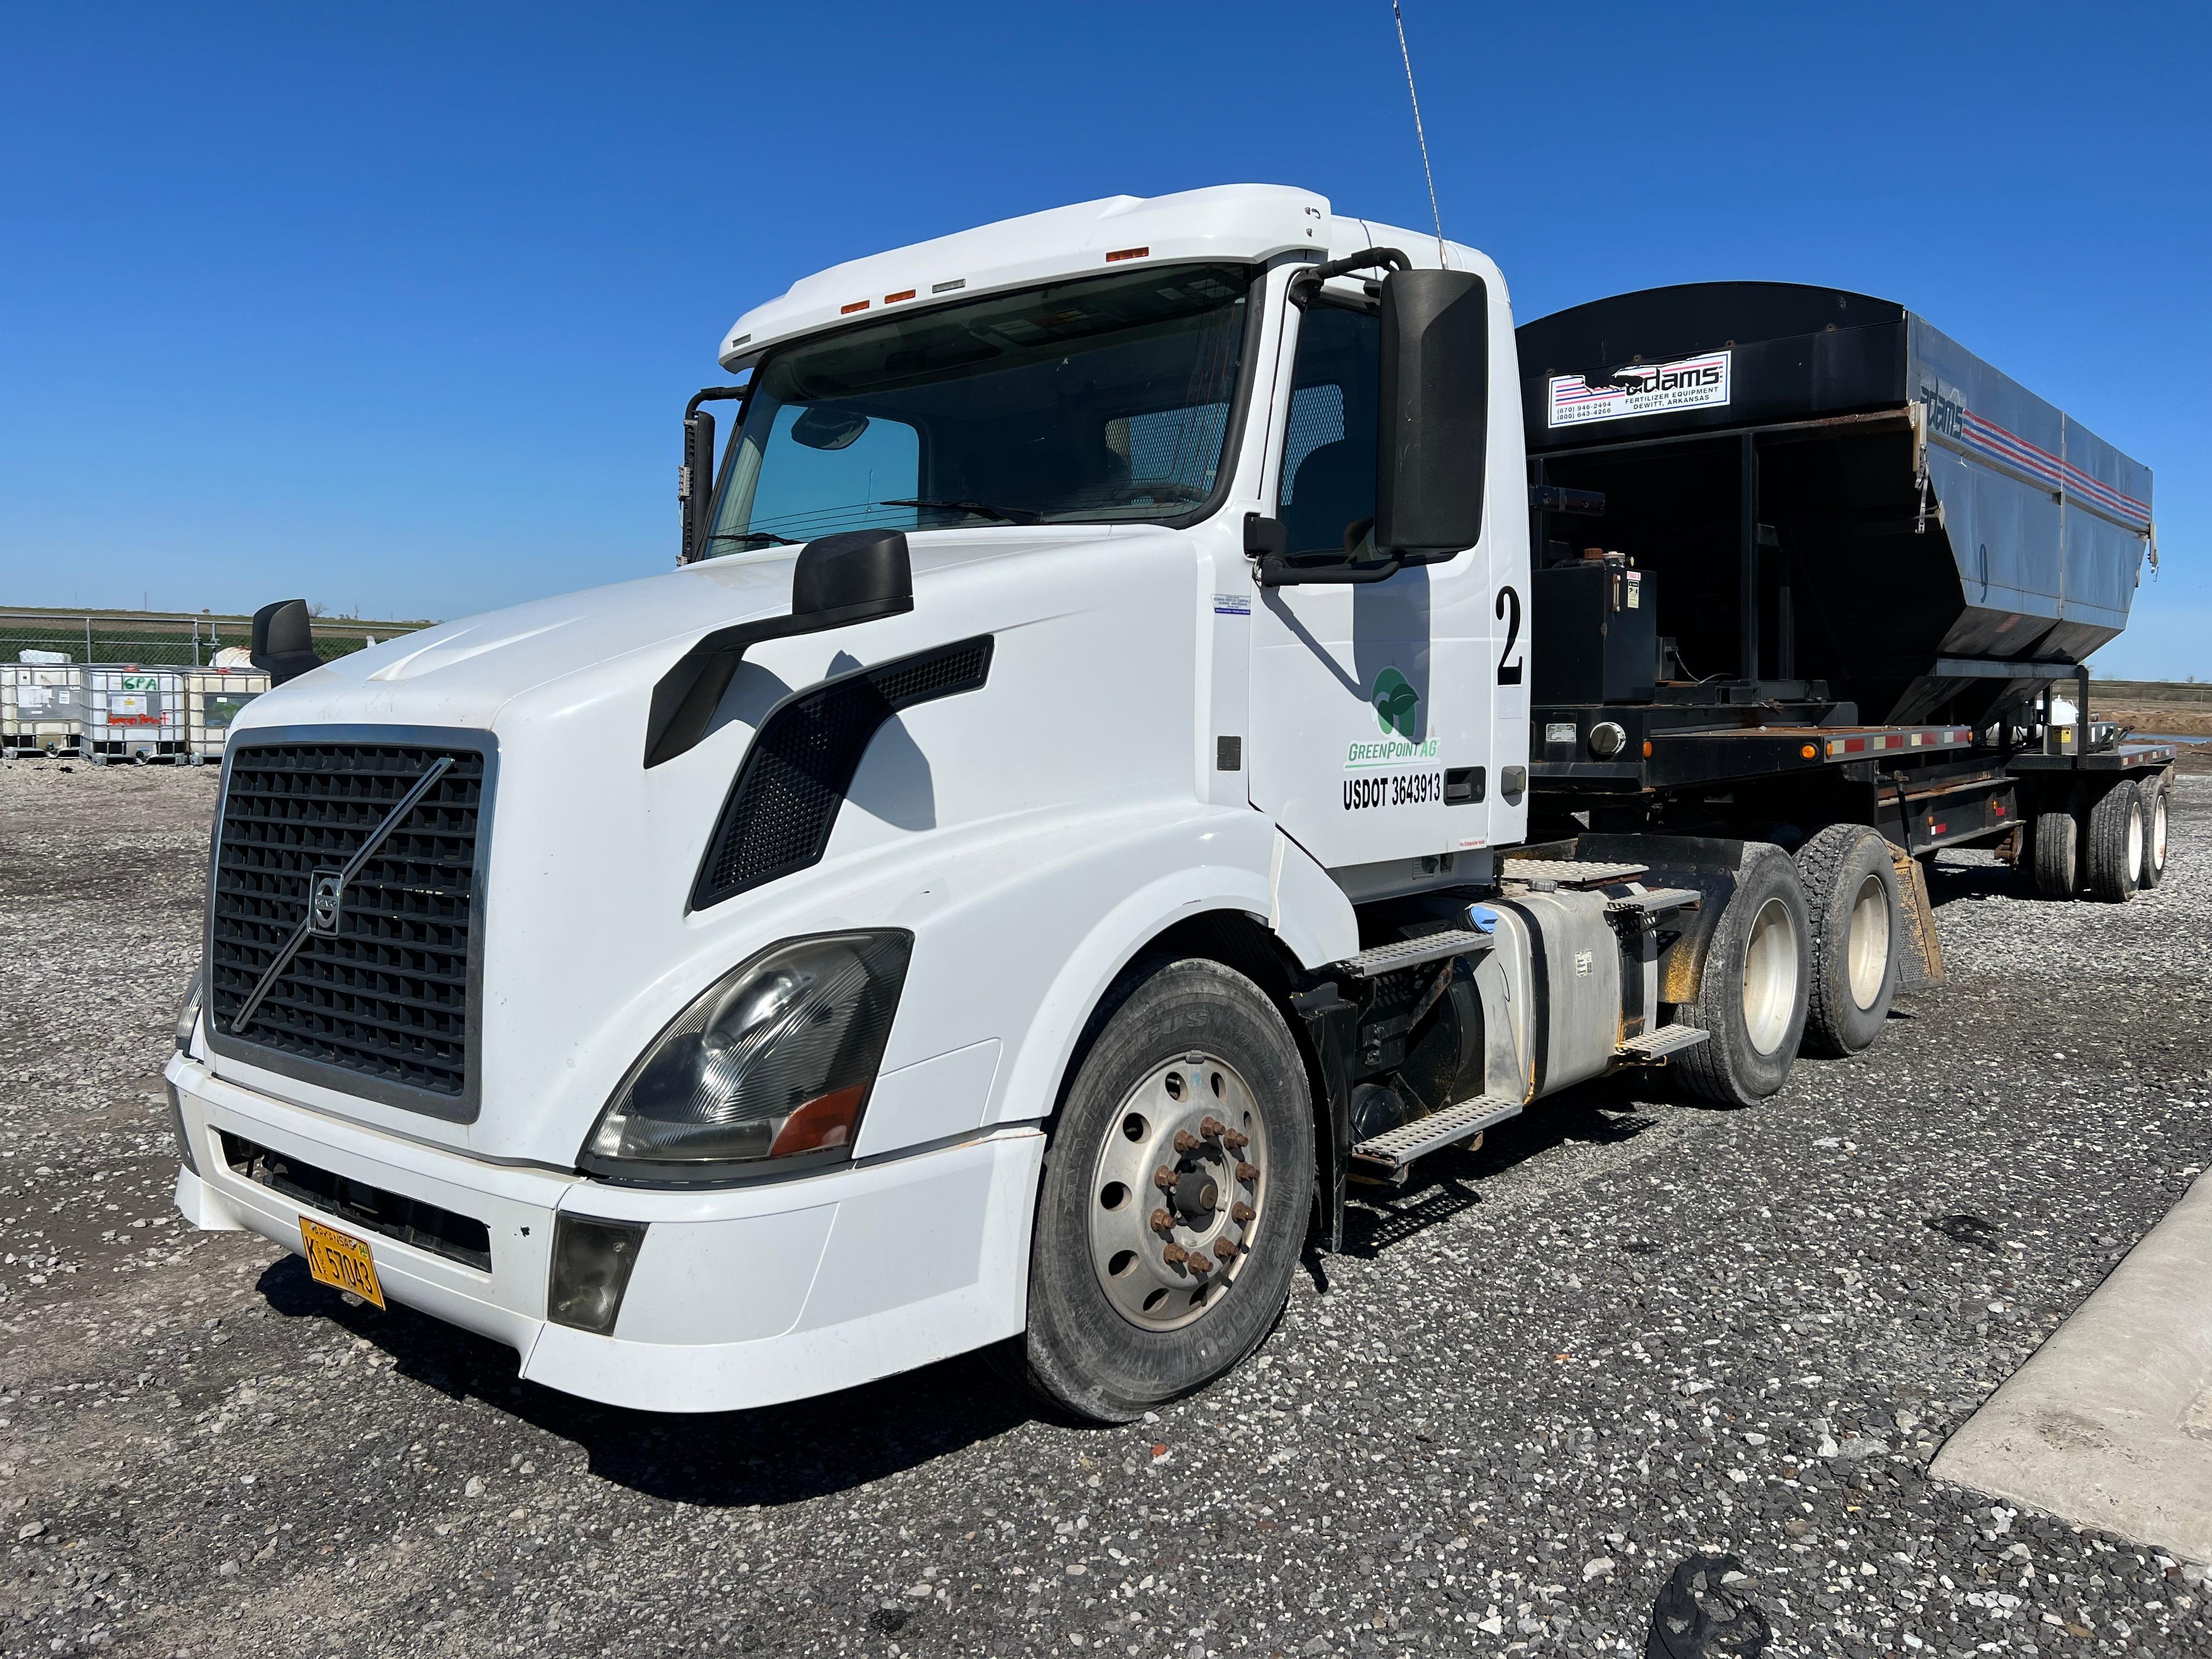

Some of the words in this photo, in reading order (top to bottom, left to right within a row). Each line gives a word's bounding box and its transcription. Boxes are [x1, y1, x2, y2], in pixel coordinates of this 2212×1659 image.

[1625, 393, 1669, 404] FERTILIZER
[1672, 386, 1719, 398] EQUIPMENT
[1633, 401, 1664, 410] DEWITT,
[1667, 394, 1709, 405] ARKANSAS
[1577, 401, 1611, 411] 946-2494
[1557, 413, 1575, 421] (800)
[1496, 585, 1523, 685] 2
[1420, 740, 1437, 757] AG
[1344, 777, 1388, 810] USDOT
[1392, 772, 1440, 806] 3643913
[315, 1227, 357, 1250] ARKANSAS
[306, 1236, 323, 1274] K
[325, 1246, 373, 1294] 57043
[315, 1240, 329, 1275] TRUCK
